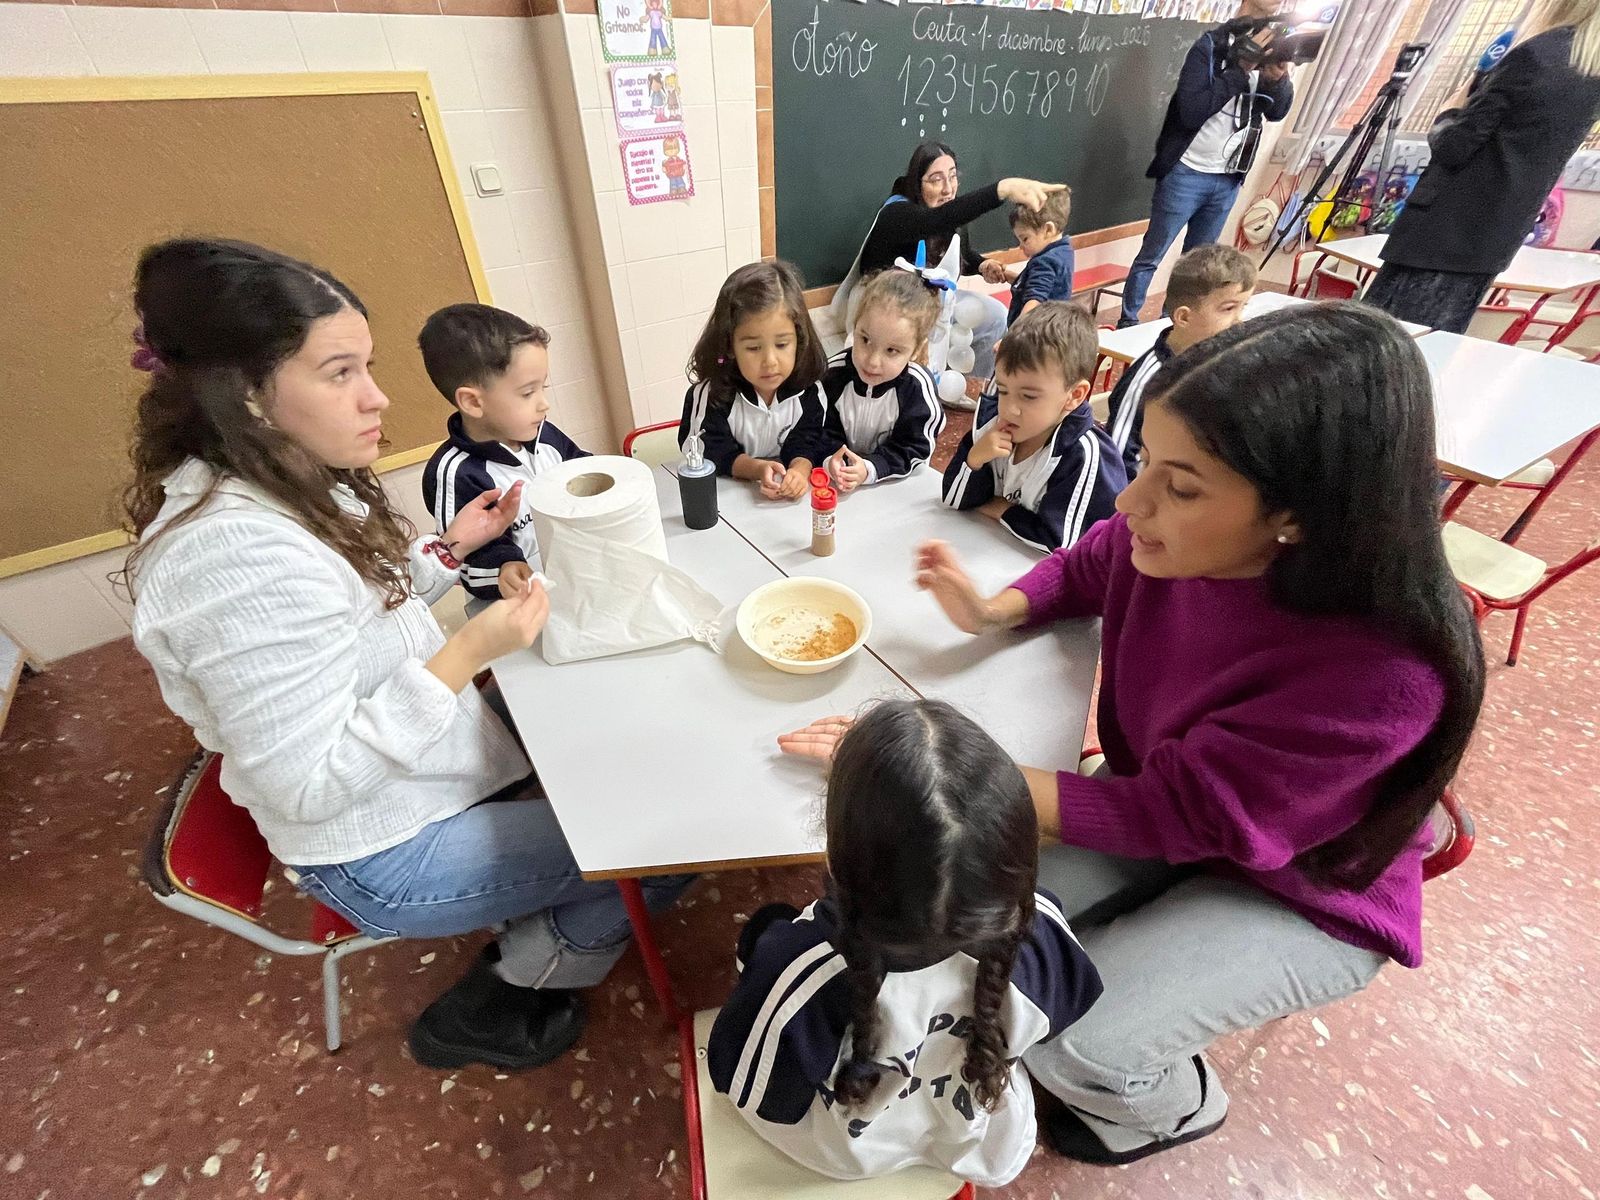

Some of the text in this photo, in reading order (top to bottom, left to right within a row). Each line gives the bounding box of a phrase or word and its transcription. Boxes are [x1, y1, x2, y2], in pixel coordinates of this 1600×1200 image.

[616, 5, 630, 19] No
[913, 6, 968, 46] Ceuta
[898, 54, 911, 106] 1
[915, 57, 935, 106] 2
[936, 54, 957, 104] 3
[962, 62, 977, 114] 4
[980, 64, 998, 115] 5
[1002, 70, 1019, 115] 6
[1026, 70, 1040, 115] 7
[1041, 70, 1060, 118] 8
[1065, 67, 1077, 113] 9
[1085, 63, 1110, 116] 10
